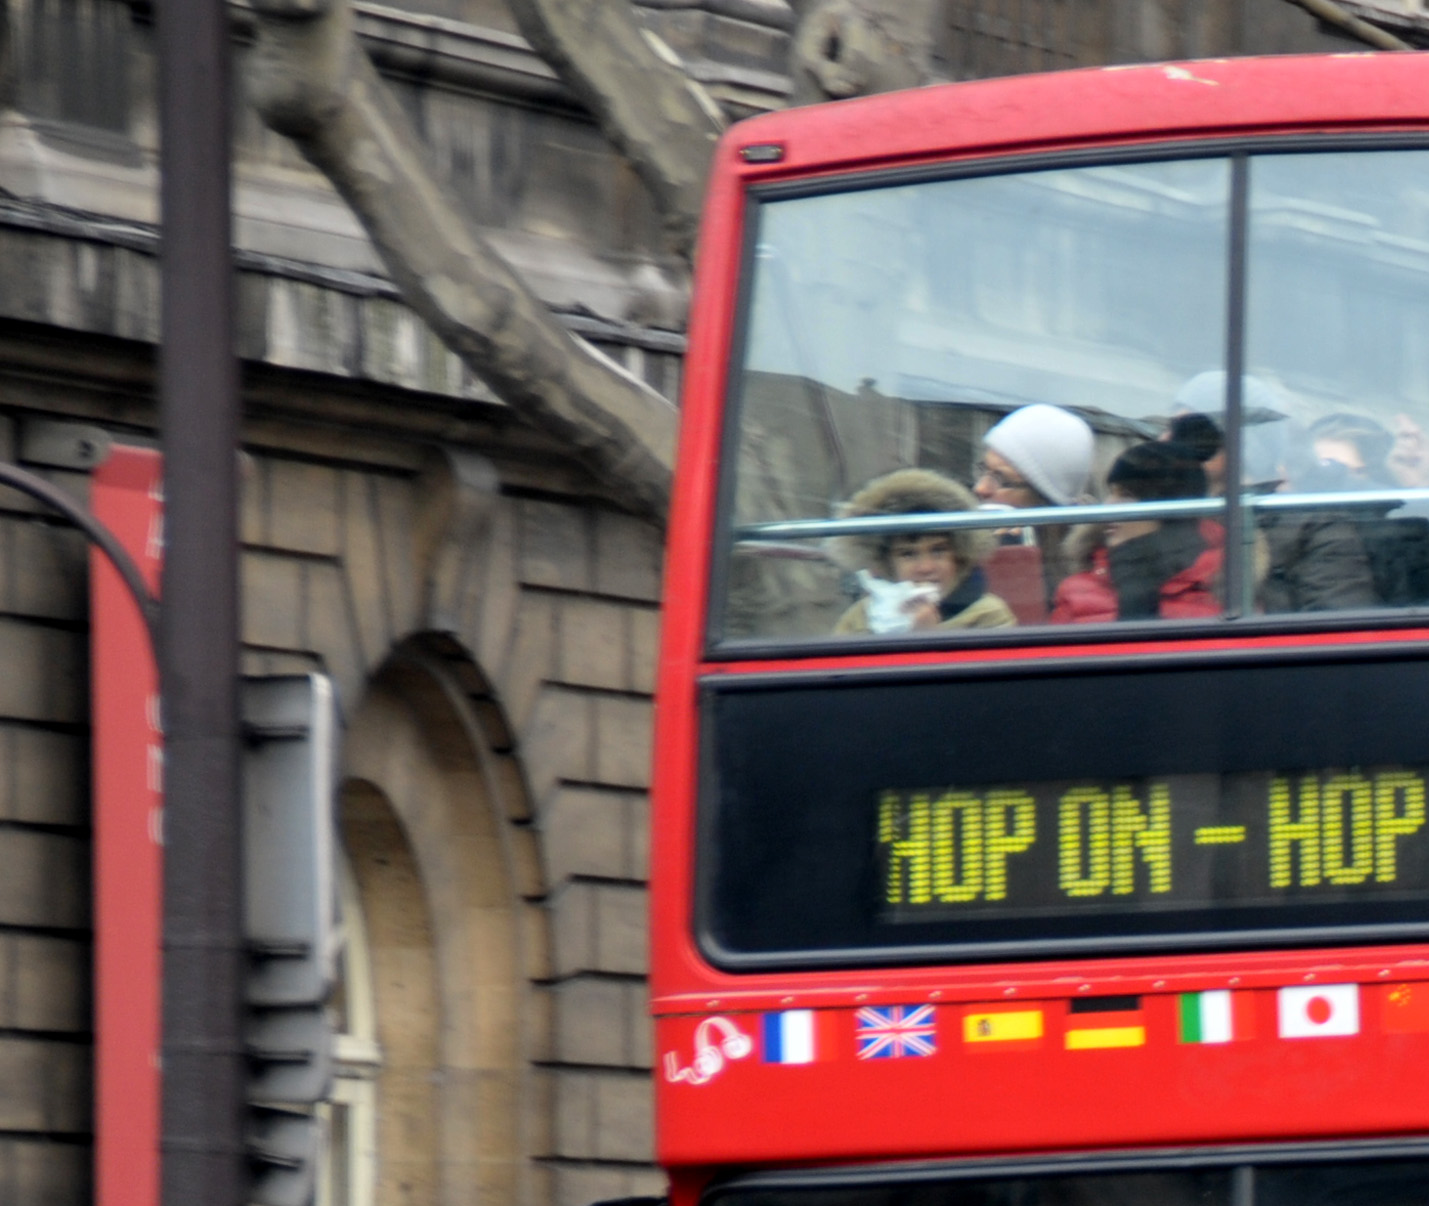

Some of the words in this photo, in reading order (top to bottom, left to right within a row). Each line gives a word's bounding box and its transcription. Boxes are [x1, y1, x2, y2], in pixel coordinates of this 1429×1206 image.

[878, 789, 1036, 906] HOP
[1058, 782, 1172, 897] ON
[1268, 769, 1426, 889] HOP
